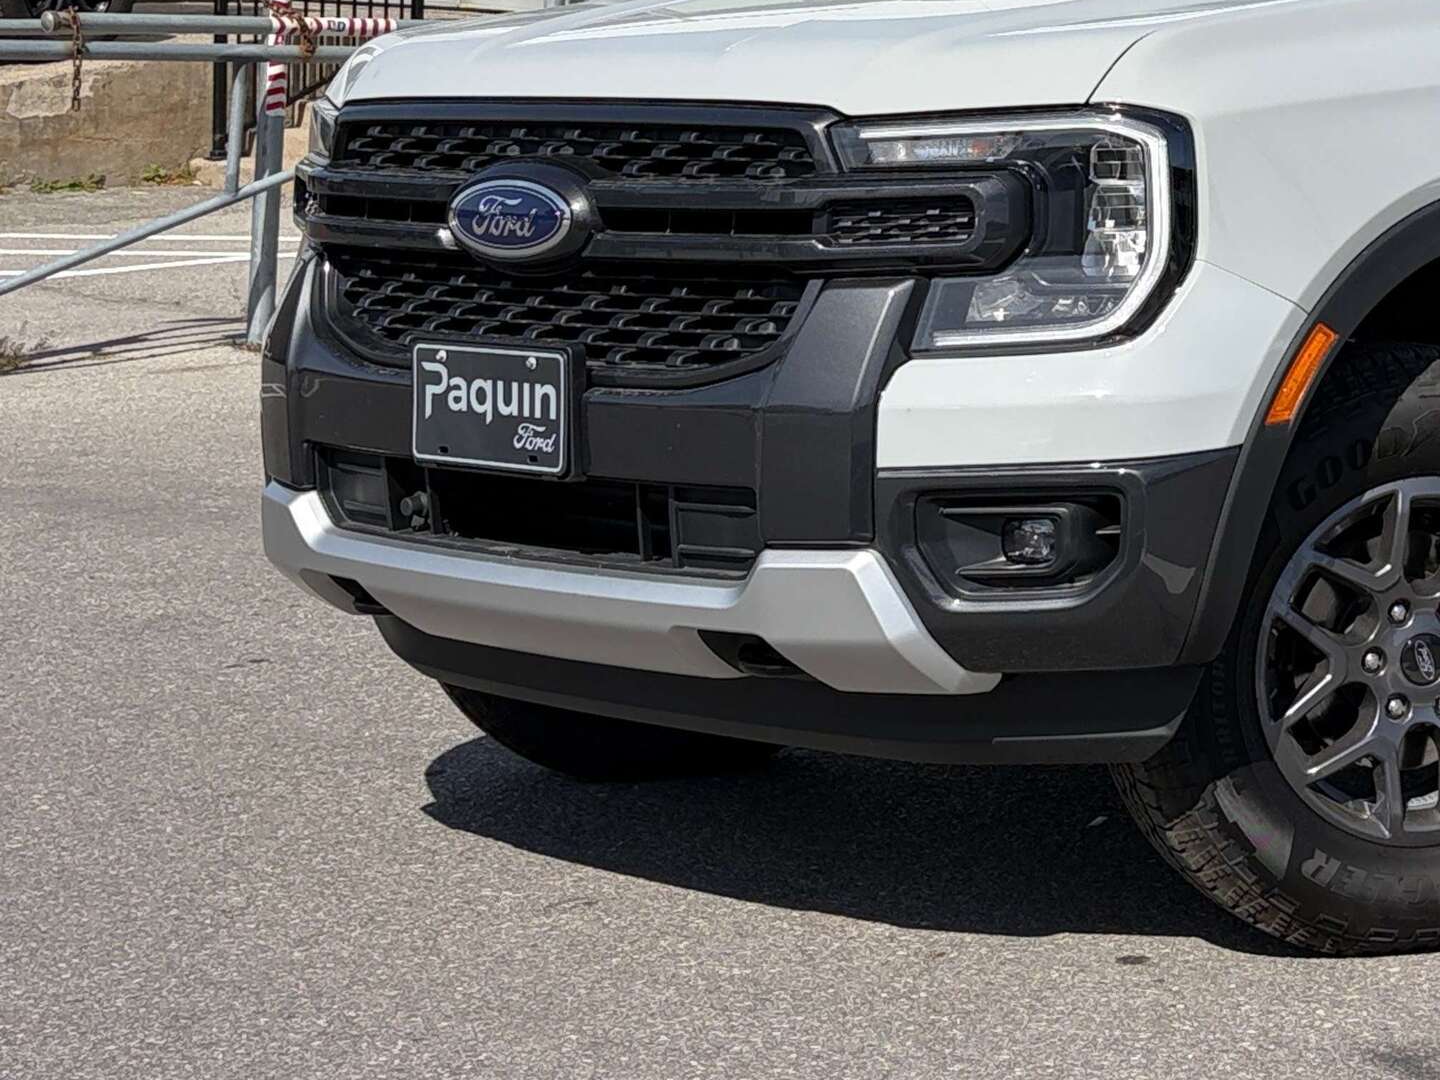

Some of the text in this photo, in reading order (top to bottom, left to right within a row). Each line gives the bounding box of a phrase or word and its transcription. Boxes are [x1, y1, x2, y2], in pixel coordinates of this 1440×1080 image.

[471, 195, 538, 238] Ford
[421, 361, 556, 424] Paquin
[513, 423, 556, 453] Ford
